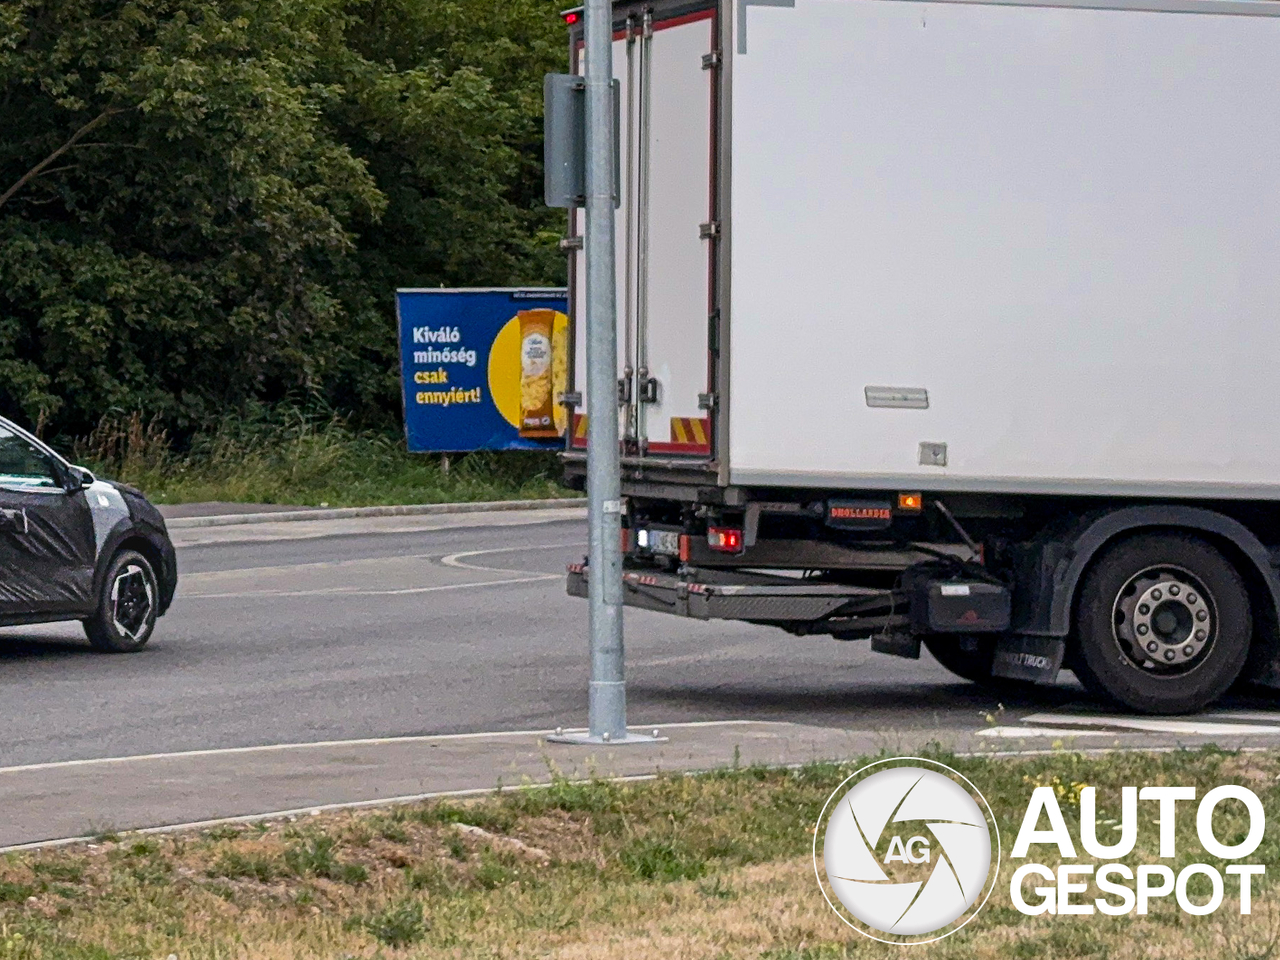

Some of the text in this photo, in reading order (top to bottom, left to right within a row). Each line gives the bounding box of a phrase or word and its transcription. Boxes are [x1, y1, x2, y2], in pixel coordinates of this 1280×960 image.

[413, 326, 460, 343] Kiváló
[413, 346, 476, 367] minőség
[414, 366, 448, 384] csak
[416, 386, 480, 407] ennyiért!
